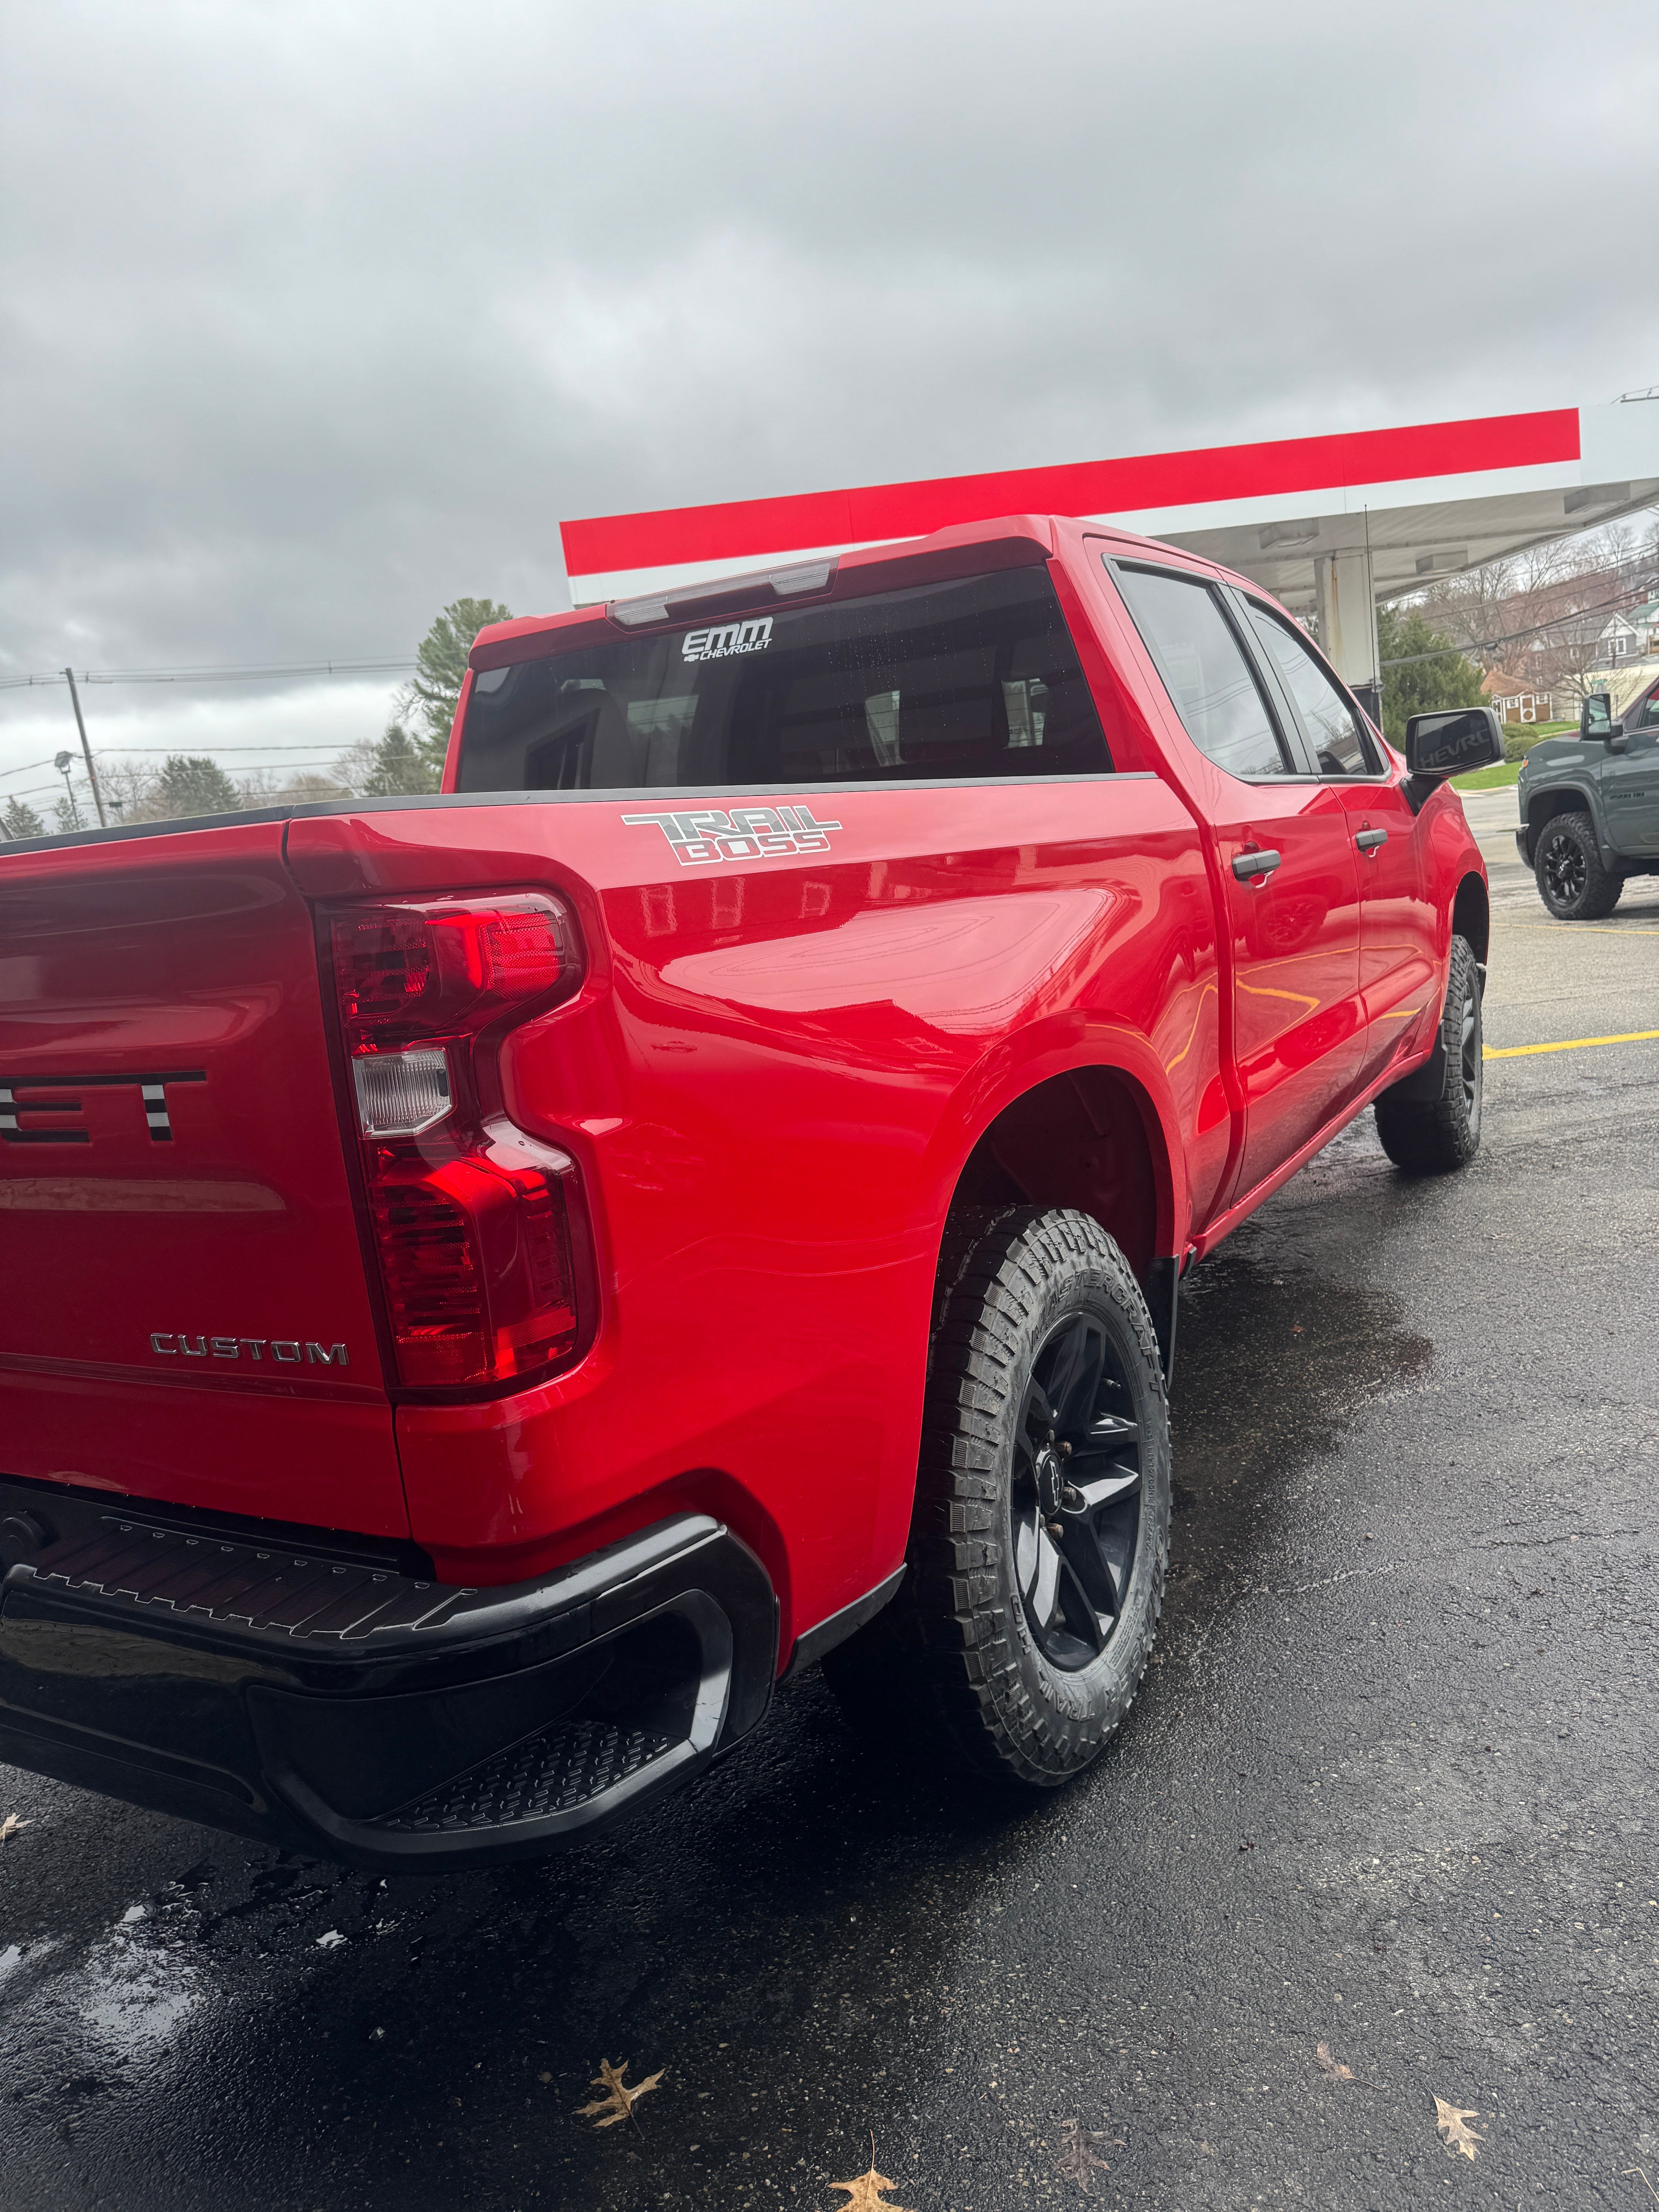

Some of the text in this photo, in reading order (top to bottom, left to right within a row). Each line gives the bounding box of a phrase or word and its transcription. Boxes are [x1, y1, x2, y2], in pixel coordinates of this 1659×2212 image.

[699, 638, 772, 661] CHEVROLET
[620, 805, 843, 842] TRAIL
[670, 830, 831, 866] BOSS
[150, 1332, 349, 1365] CUSTOM
[1024, 1267, 1162, 1402] MASTERCRAFT
[1010, 1594, 1032, 1656] HD
[1039, 1668, 1096, 1723] TRAIL
